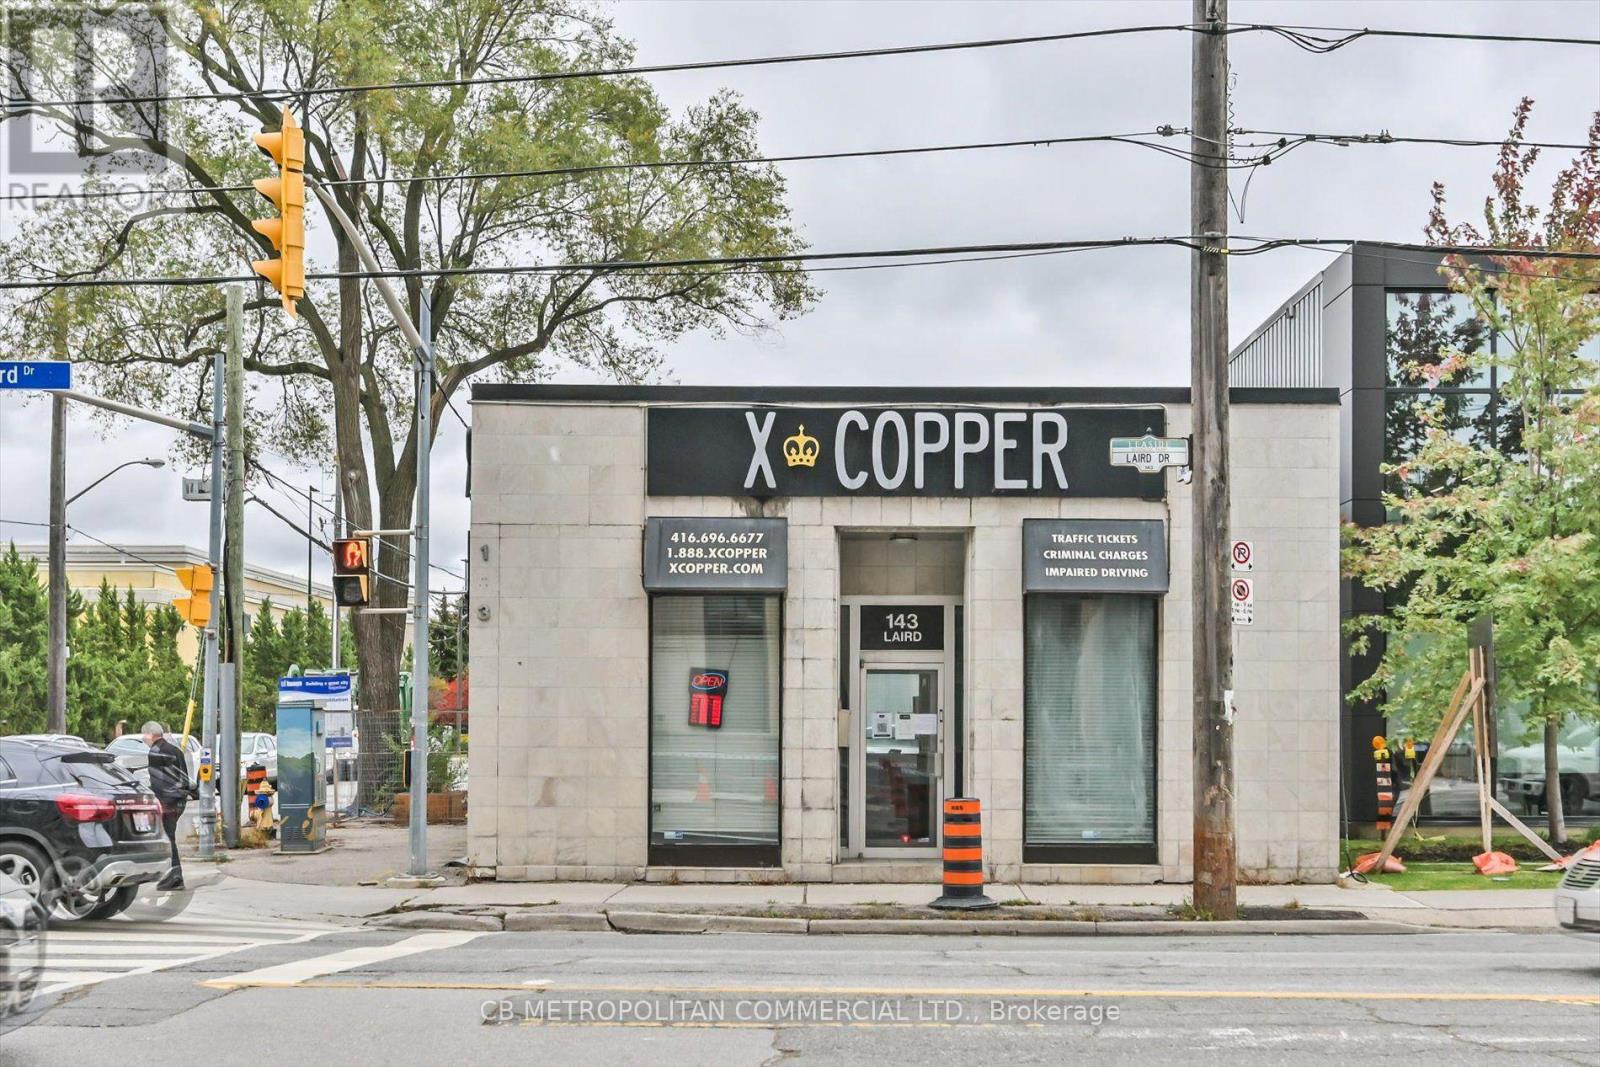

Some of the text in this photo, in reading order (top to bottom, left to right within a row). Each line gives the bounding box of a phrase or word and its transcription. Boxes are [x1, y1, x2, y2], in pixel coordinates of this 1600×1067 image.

[0, 365, 35, 384] rd Dr
[743, 409, 1069, 489] X COPPER
[1126, 453, 1170, 463] LAIRD DR
[670, 532, 764, 544] 416.696.6677
[1051, 534, 1139, 544] TRAFFIC TICKETS
[666, 547, 768, 559] 1.888.XCOPPER
[1043, 550, 1149, 561] CRIMINAL CHARGES
[668, 562, 764, 574] XCOPPER.COM
[1045, 567, 1149, 578] IMPAIRED DRIVING
[885, 613, 919, 630] 143
[883, 631, 922, 643] LAIRD
[693, 674, 723, 687] OPEN
